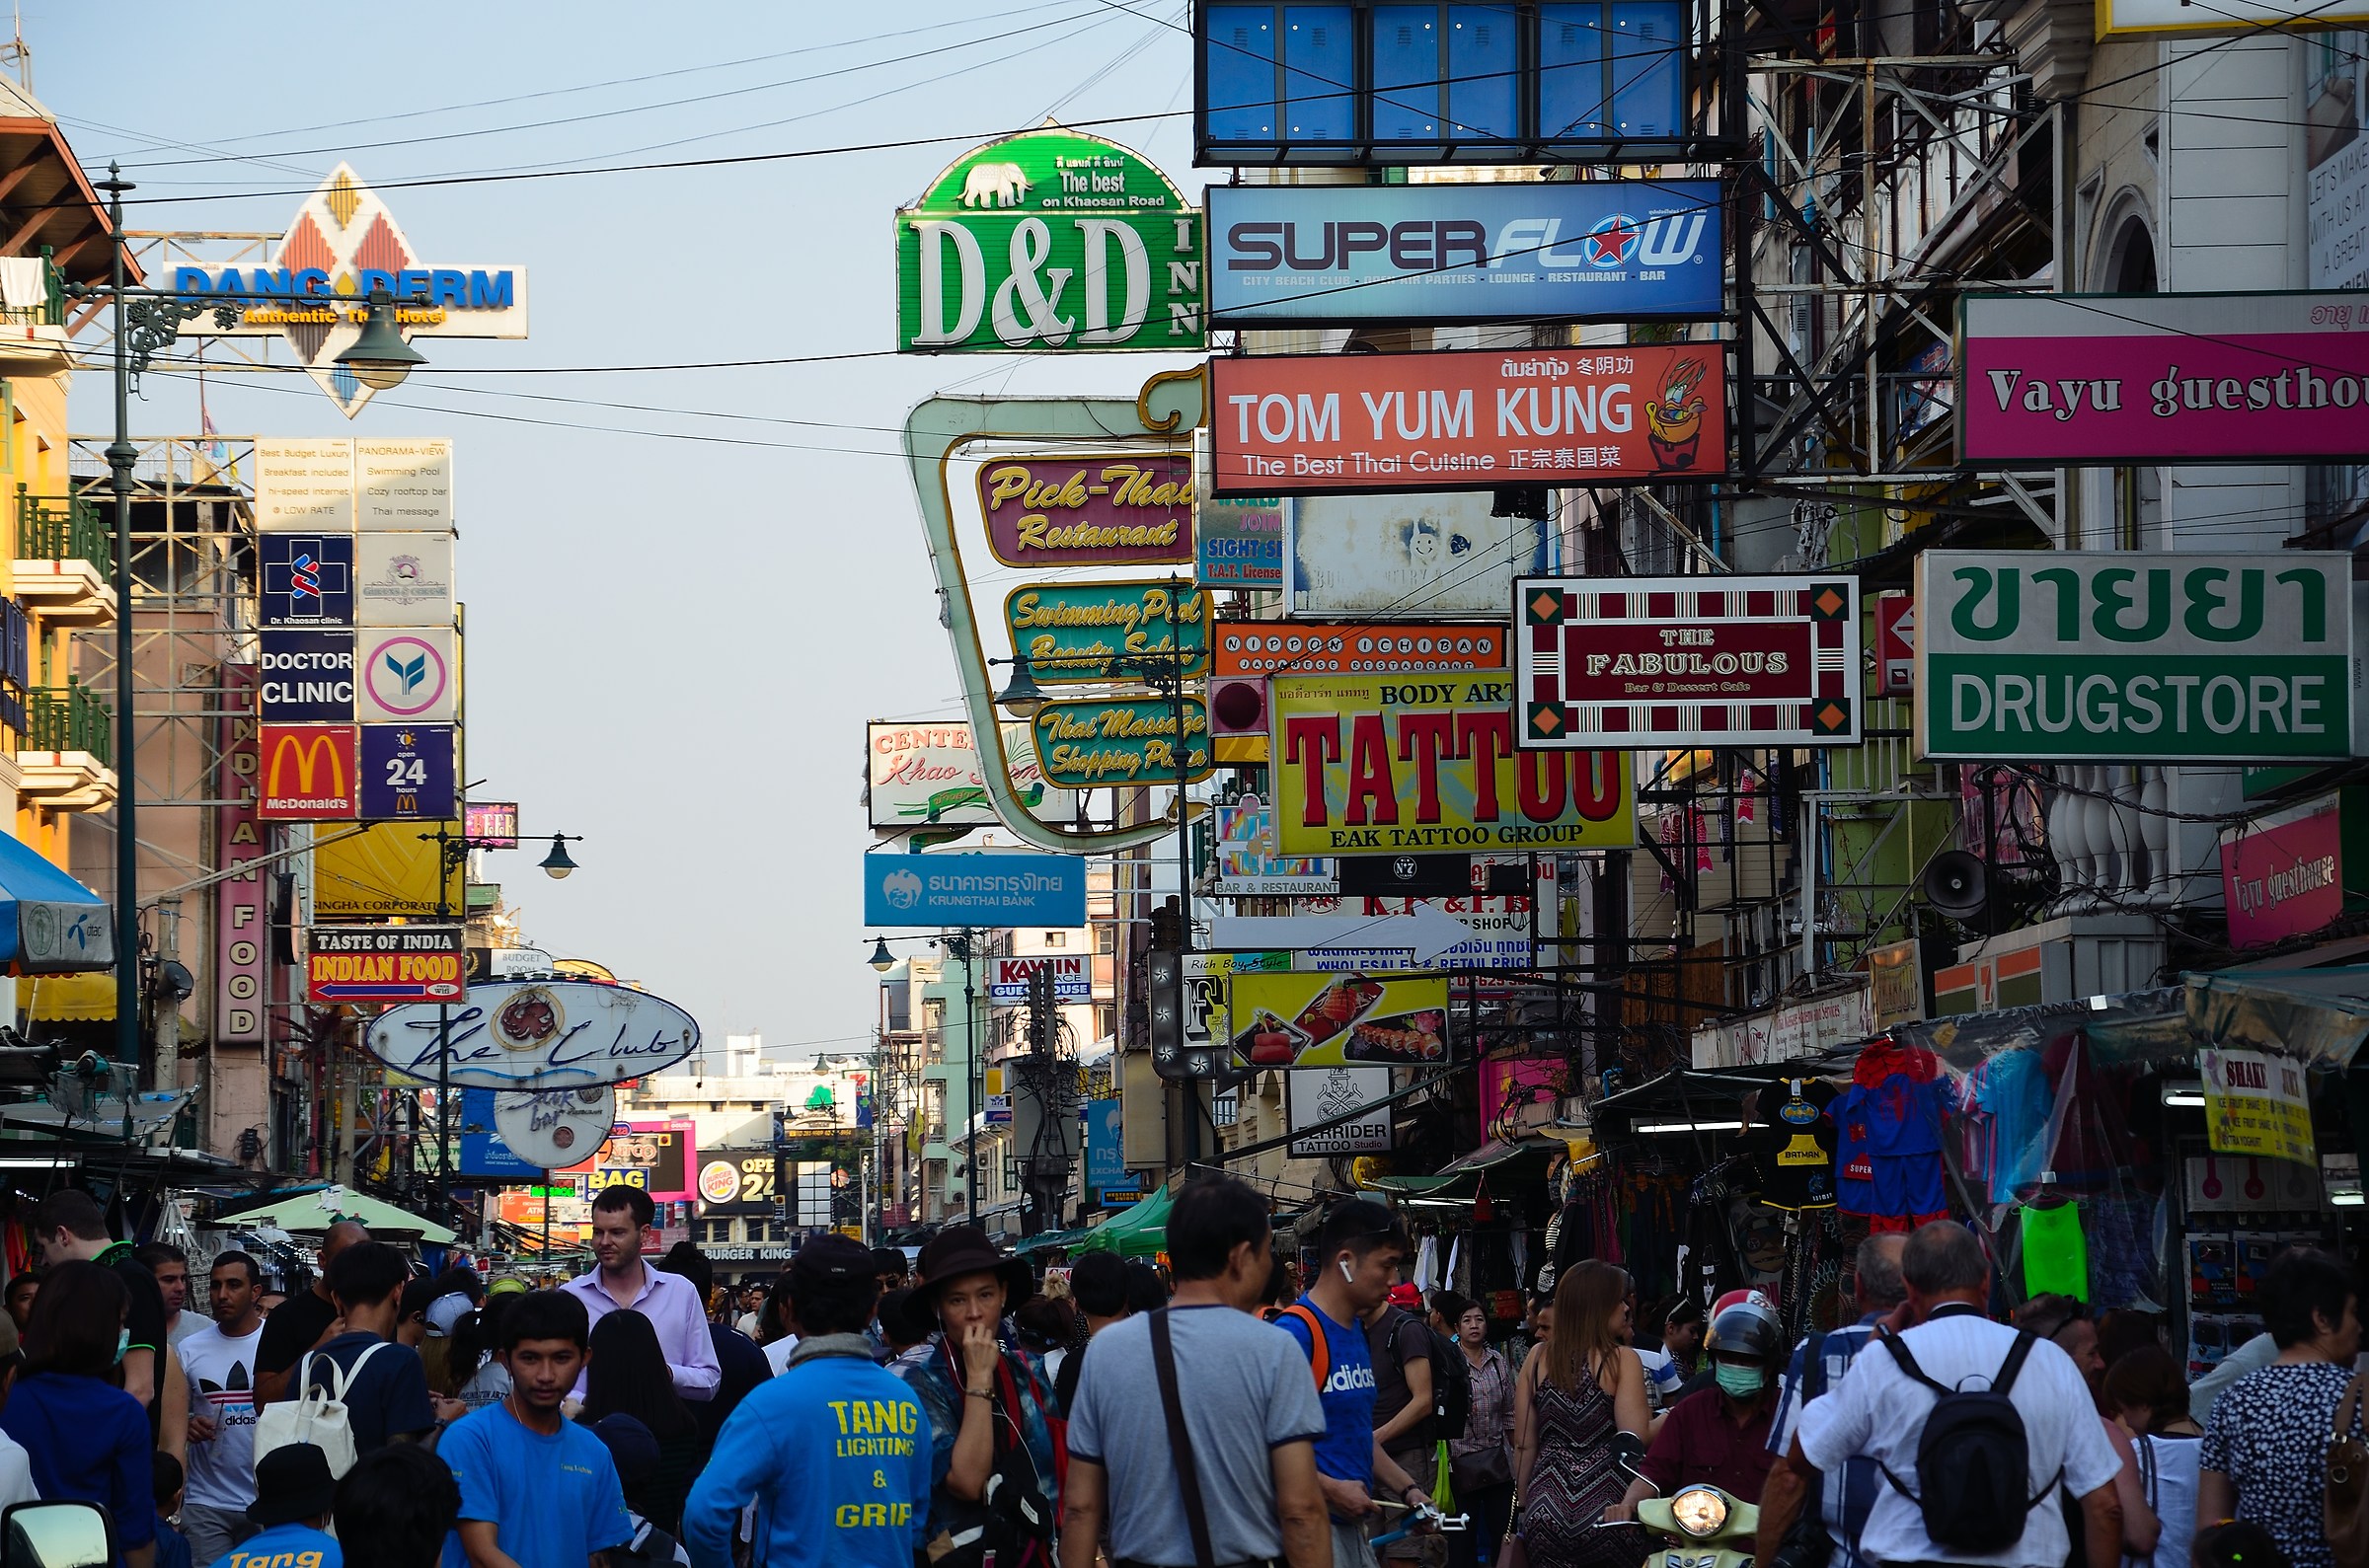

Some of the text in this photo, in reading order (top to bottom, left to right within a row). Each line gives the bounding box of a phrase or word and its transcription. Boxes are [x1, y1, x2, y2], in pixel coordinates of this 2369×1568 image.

[1060, 171, 1125, 193] The best
[1042, 195, 1165, 207] on Khaosan Road
[2310, 185, 2368, 245] WITH US AT
[2323, 226, 2367, 277] A GREAT
[175, 266, 513, 307] DANG DERM
[909, 217, 1150, 347] D&D
[1167, 218, 1200, 336] INN
[1243, 276, 1270, 286] CITY
[1275, 275, 1315, 286] BEACH
[1320, 275, 1350, 286] CLUB
[1425, 273, 1476, 284] PARTIES
[1489, 273, 1535, 283] LOUNGE
[1548, 271, 1627, 283] RESTAURANT
[1640, 270, 1666, 281] BAR
[244, 309, 447, 325] Authentic Hotel
[2311, 305, 2353, 331] วายุ
[1500, 356, 1634, 381] ต้มยำกุ้ง 冬阴功
[1985, 364, 2369, 422] Vayu guestho
[1228, 383, 1633, 443] TOM YUM KUNG
[284, 450, 317, 459] Budget
[321, 450, 349, 459] Luxury
[358, 447, 446, 456] PANORAMA-VIEW
[1243, 446, 1621, 476] The Best Thai Cuisine 正宗泰国菜
[265, 468, 348, 477] Breakfast included
[366, 467, 417, 478] Swimming
[268, 487, 308, 496] hi-speed
[367, 487, 390, 496] Cozy
[394, 487, 428, 497] rooftop
[284, 506, 306, 515] LOW
[1017, 514, 1180, 552] Restaurant
[1207, 538, 1261, 559] SIGHT
[1207, 563, 1239, 579] T.A.T.
[1014, 592, 1140, 635] Swimming
[1950, 566, 2327, 643] ขายยา
[1225, 636, 1491, 653] NIPPON ICHIBAN
[1659, 629, 1716, 646] THE
[262, 653, 352, 670] DOCTOR
[1031, 635, 1115, 675] Beauty
[1240, 659, 1474, 670] JAPANESE RESTAURANT
[1586, 651, 1790, 676] FABULOUS
[262, 682, 352, 704] CLINIC
[1380, 683, 1457, 706] BODY
[1624, 682, 1649, 693] Bar
[1652, 682, 1664, 692] &
[1667, 682, 1719, 692] Dessert
[1951, 673, 2326, 734] DRUGSTORE
[1039, 713, 1098, 742] Thai
[875, 728, 976, 754] CENTE
[386, 759, 426, 785] 24
[876, 755, 962, 786] Khao
[1050, 744, 1142, 779] Shopping
[1284, 709, 1622, 827] TATTOO
[230, 684, 259, 882] INDIAN
[267, 797, 348, 809] McDonald's
[473, 813, 514, 837] BEER
[1330, 824, 1583, 849] EAK TATTOO GROUP
[929, 872, 1063, 896] ธนาคารกรุงไทย
[1216, 882, 1338, 893] BAR & RESTAURANT
[2233, 855, 2335, 919] Vayu guesthouse
[363, 900, 457, 911] CORPORATIN
[929, 896, 1034, 907] KRUNGTHAI BANK
[86, 924, 102, 936] dtac
[1472, 918, 1511, 930] SHOP
[318, 934, 453, 949] TASTE OF INDIA
[502, 953, 541, 962] BUDGET
[1191, 959, 1216, 969] Rich
[229, 904, 257, 1034] FOOD
[312, 956, 457, 981] INDIAN FOOD
[405, 1007, 679, 1071] The Club
[1298, 1140, 1383, 1152] TATTOO Studio
[588, 1170, 645, 1188] BAG
[706, 1171, 732, 1183] BURGER
[1850, 1164, 1872, 1174] SUPER
[707, 1177, 733, 1192] KING
[705, 1248, 792, 1260] BURGER KING
[827, 1400, 918, 1435] TANG
[836, 1438, 915, 1457] LIGHTING
[873, 1469, 887, 1488] &
[835, 1503, 912, 1528] GRIP
[230, 1550, 324, 1568] Tang
